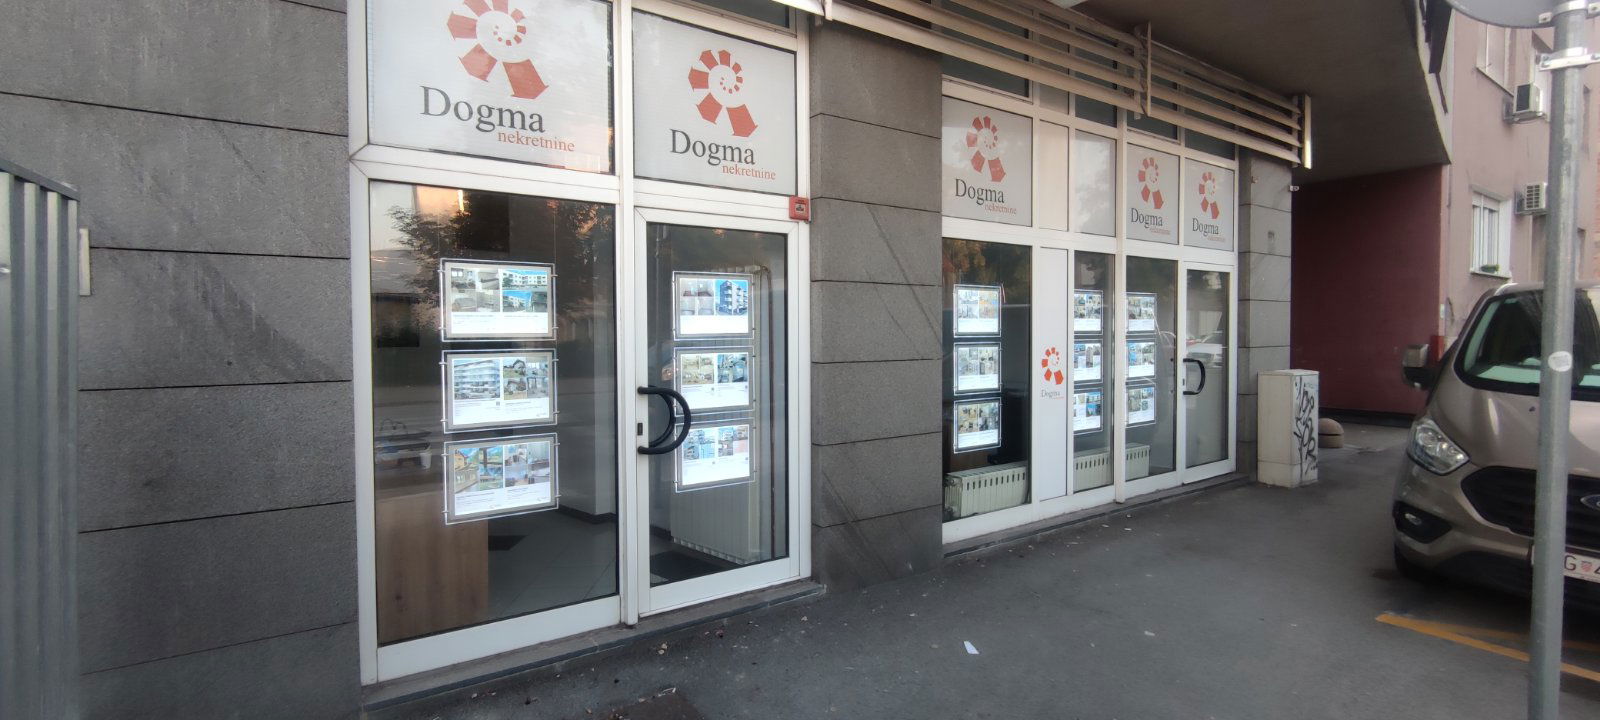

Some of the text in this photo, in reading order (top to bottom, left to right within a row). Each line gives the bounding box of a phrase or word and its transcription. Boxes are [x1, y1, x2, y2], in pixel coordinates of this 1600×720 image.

[420, 85, 546, 133] Dogma
[497, 131, 575, 152] nekretnine
[669, 128, 756, 166] Dogma
[722, 163, 776, 180] nekretnine
[955, 178, 1005, 205] Dogma
[1131, 207, 1163, 229] Dogma
[1192, 217, 1219, 237] Dogma
